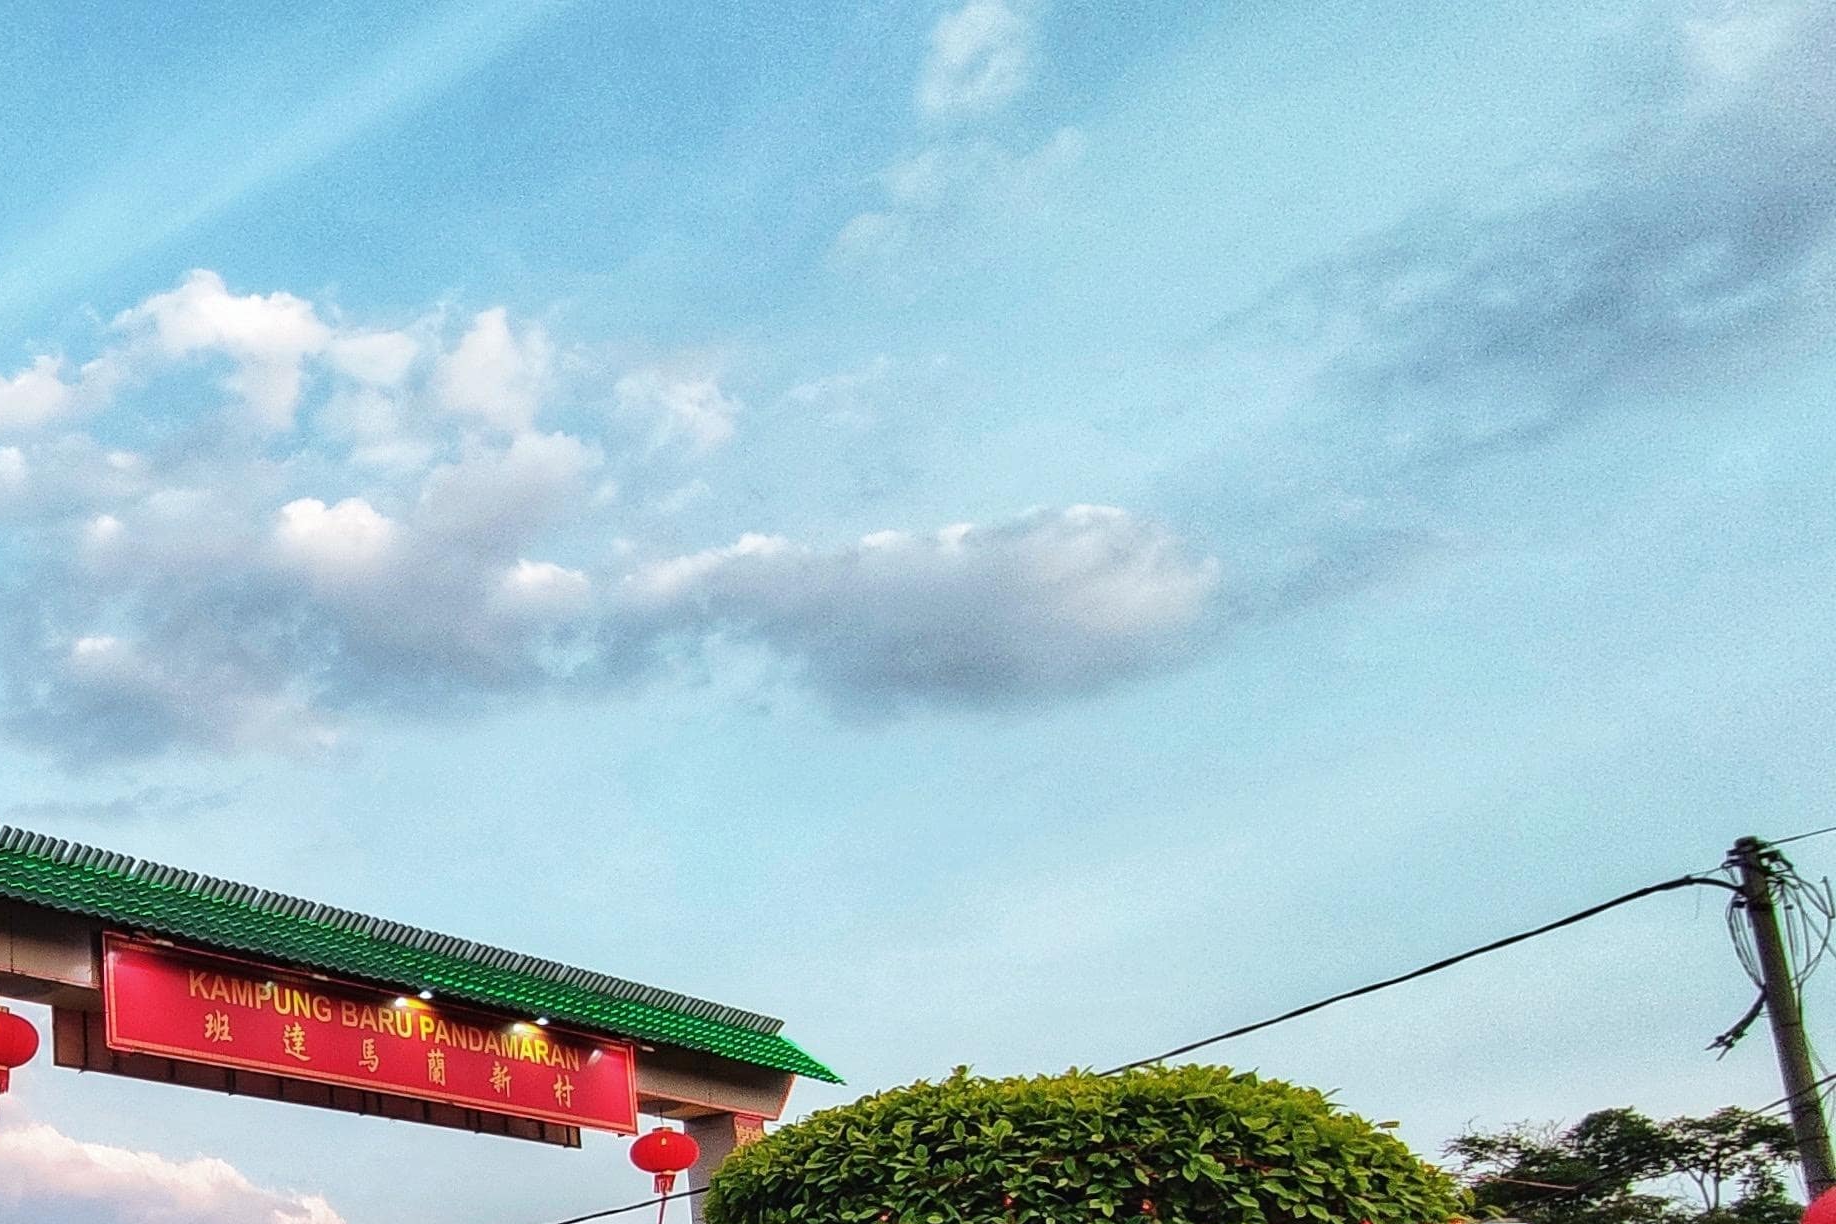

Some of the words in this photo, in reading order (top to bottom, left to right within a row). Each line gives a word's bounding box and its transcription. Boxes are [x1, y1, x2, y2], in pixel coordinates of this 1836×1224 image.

[187, 968, 332, 1022] KAMPUNG
[341, 1000, 413, 1039] BARU
[420, 1013, 581, 1073] PANDAMARAN
[203, 1009, 575, 1109] 班達馬蘭新村
